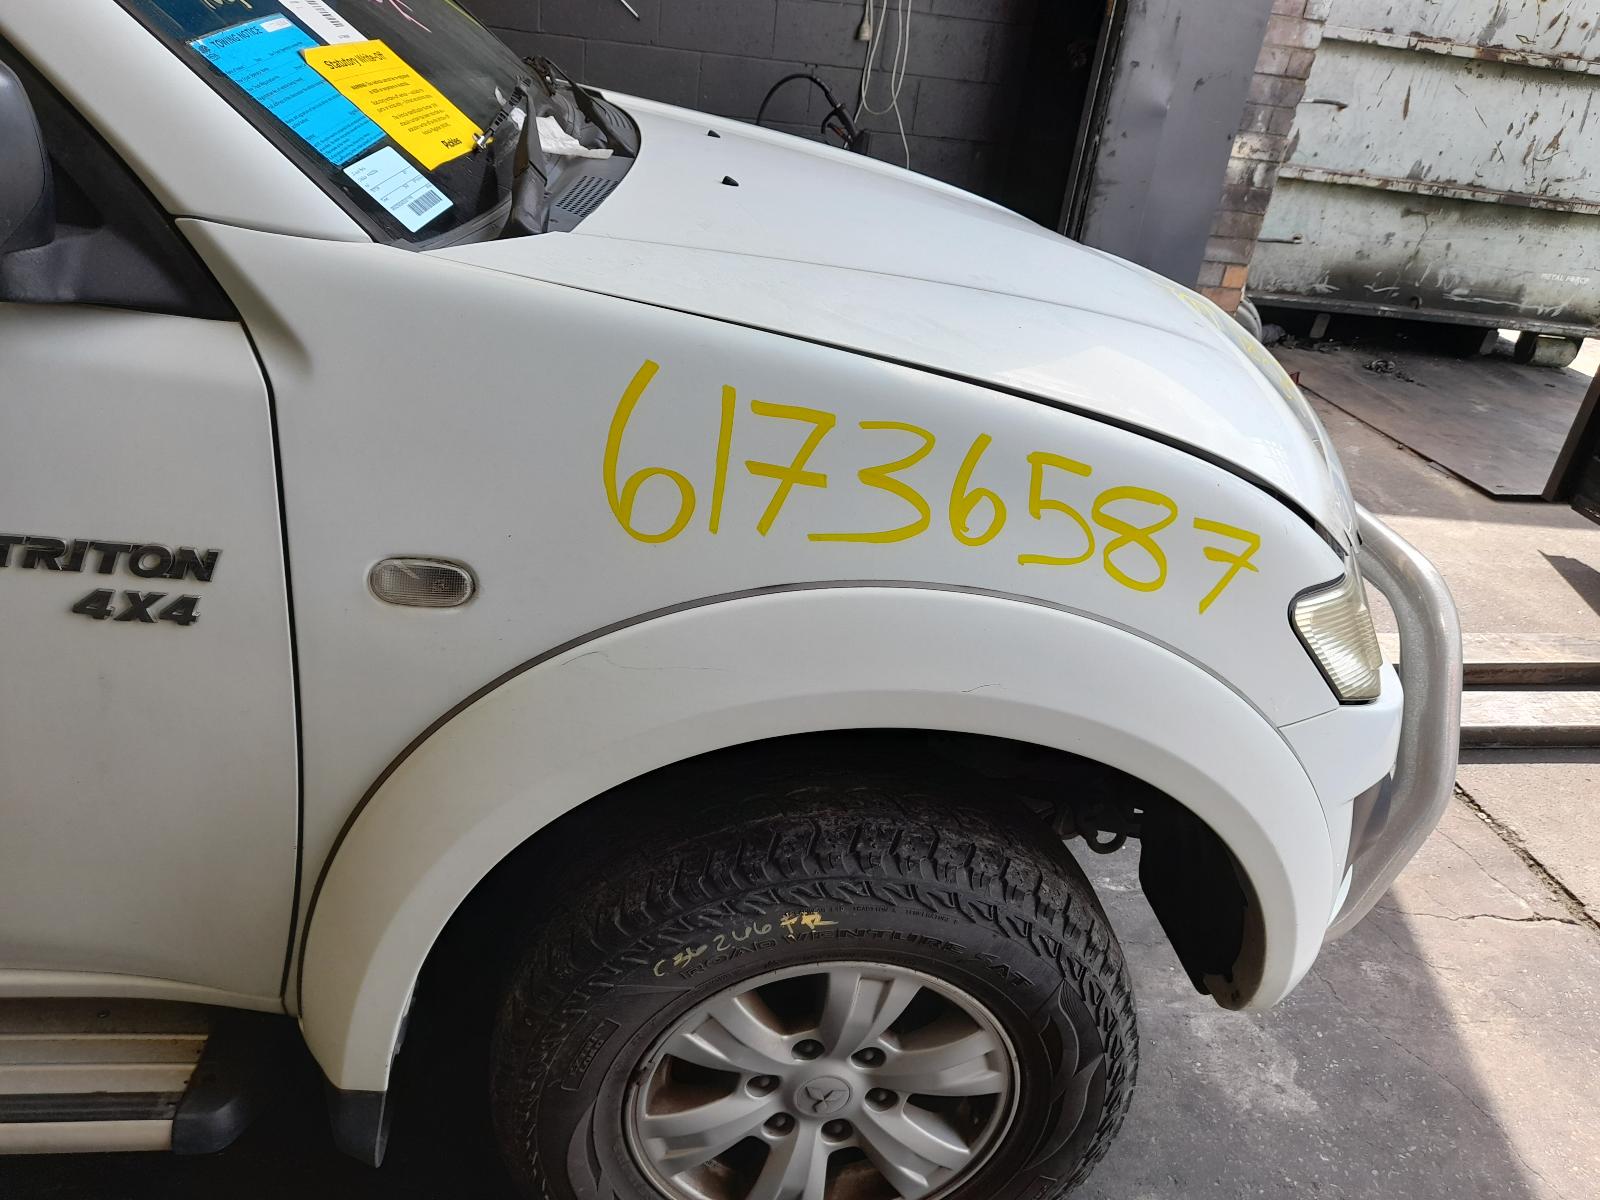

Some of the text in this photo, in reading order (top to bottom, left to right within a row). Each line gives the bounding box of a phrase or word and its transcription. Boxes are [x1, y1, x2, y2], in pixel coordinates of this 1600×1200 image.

[210, 26, 263, 49] TOWING NOTICE
[323, 54, 361, 70] Statutory
[440, 137, 462, 149] Pickles
[602, 358, 1261, 614] 61736587
[0, 533, 223, 583] TRITON
[71, 588, 202, 626] 4X4
